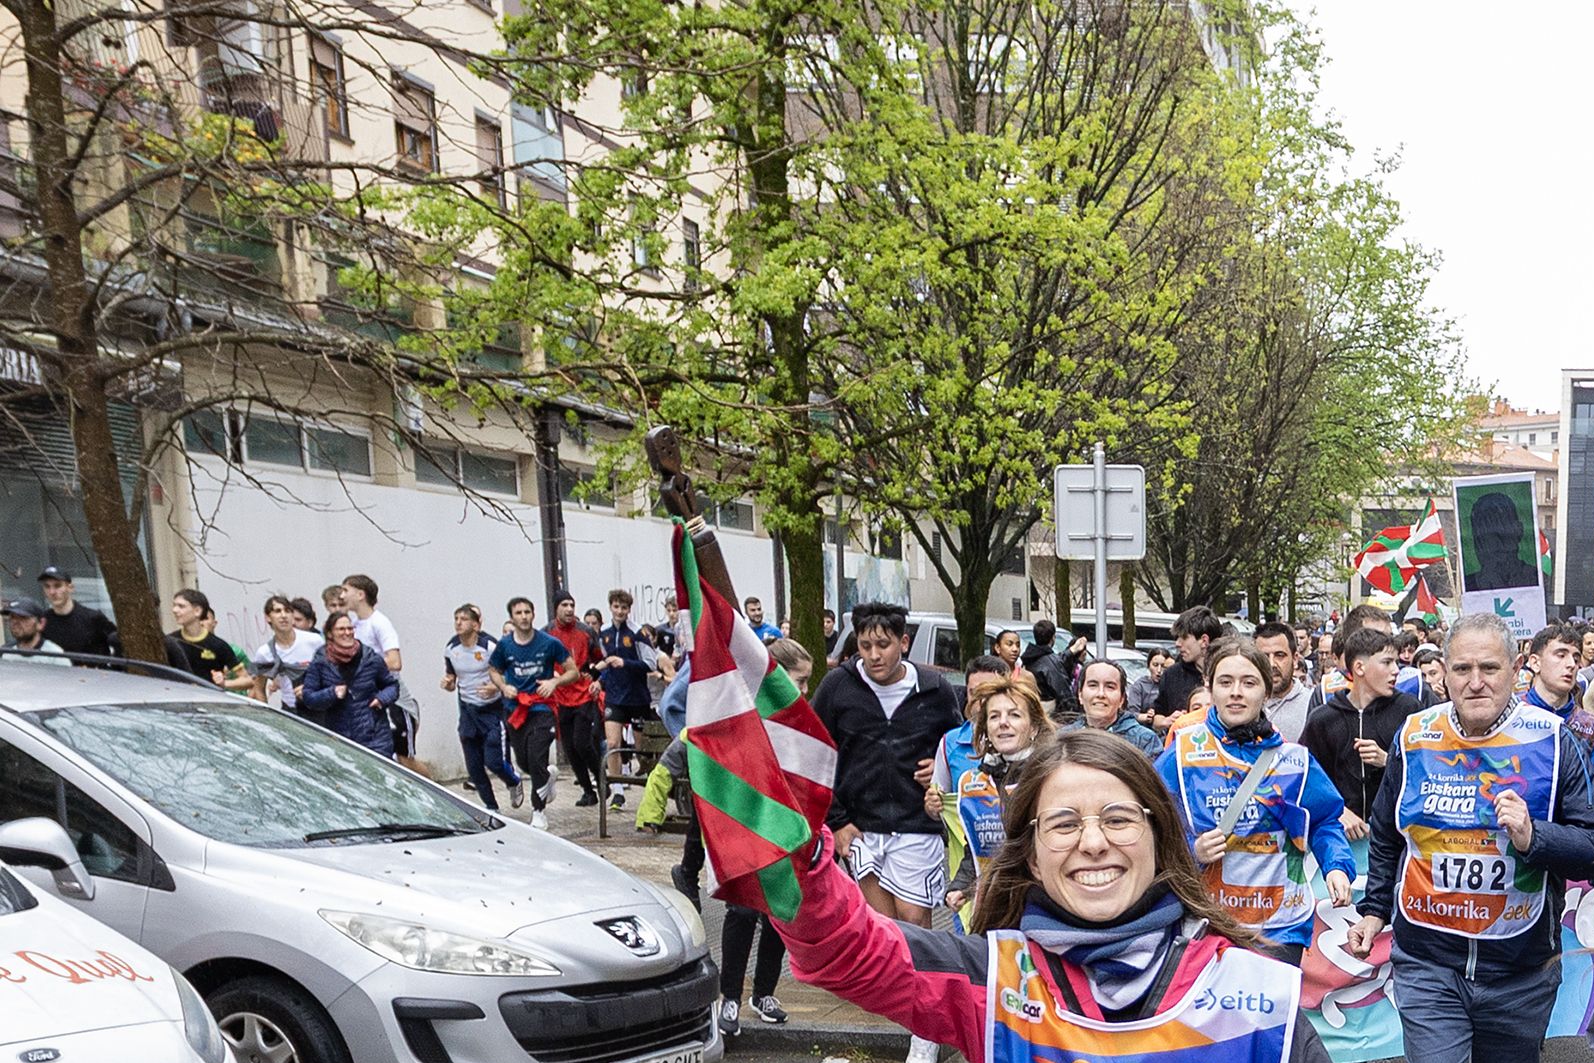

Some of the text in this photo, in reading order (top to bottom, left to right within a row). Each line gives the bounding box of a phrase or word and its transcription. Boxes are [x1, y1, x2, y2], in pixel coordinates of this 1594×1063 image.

[1525, 717, 1553, 730] eitb
[1420, 781, 1477, 797] Euskara
[1423, 795, 1477, 815] gara
[1439, 857, 1507, 890] 1782
[1406, 895, 1532, 921] 24.korrika aek
[1220, 990, 1275, 1015] eitb
[27, 1049, 55, 1063] Ford
